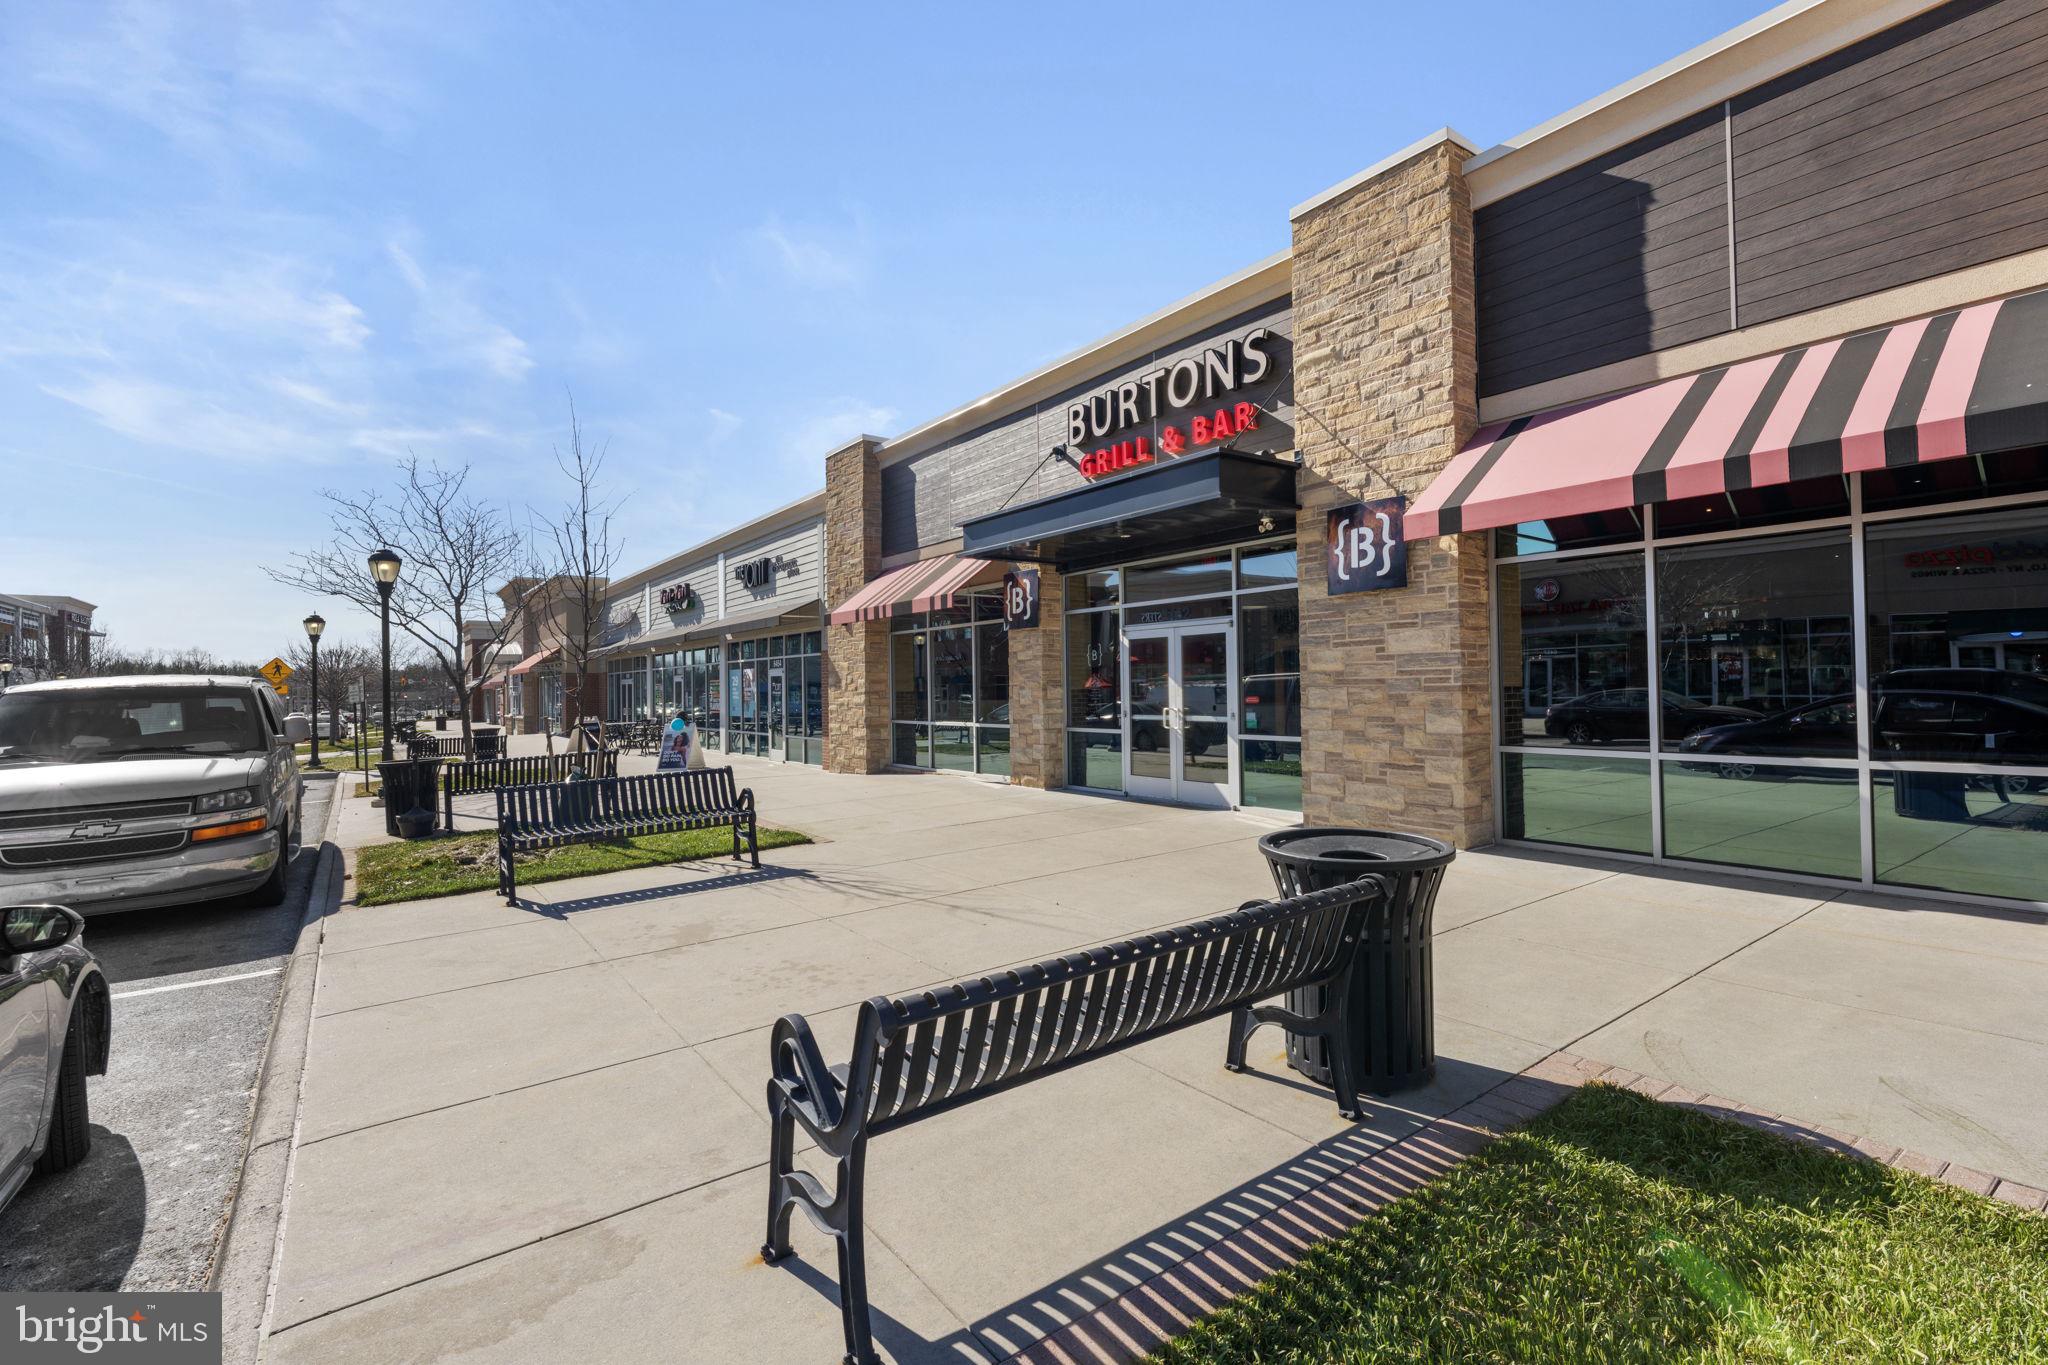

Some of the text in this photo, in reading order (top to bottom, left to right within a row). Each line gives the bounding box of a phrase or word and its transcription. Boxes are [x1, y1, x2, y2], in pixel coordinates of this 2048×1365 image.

[1067, 327, 1271, 446] BURTONS
[1080, 401, 1259, 478] GRILL & BAR
